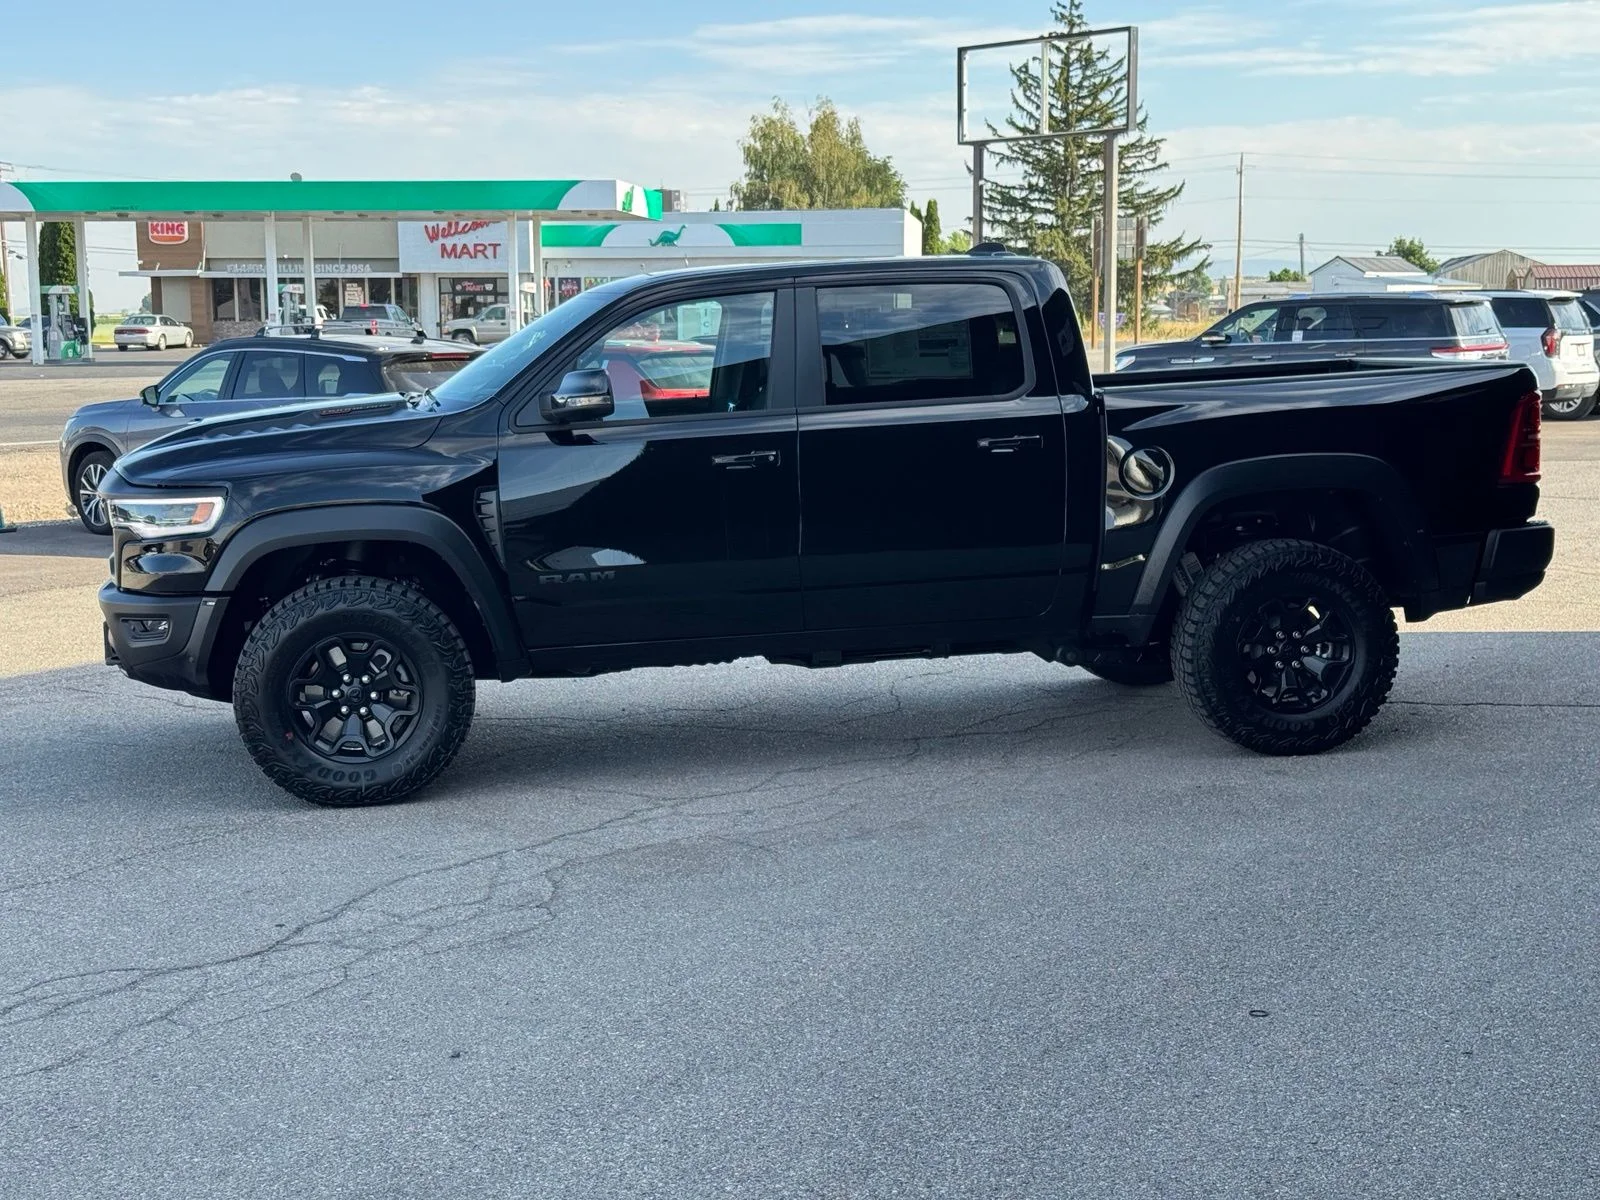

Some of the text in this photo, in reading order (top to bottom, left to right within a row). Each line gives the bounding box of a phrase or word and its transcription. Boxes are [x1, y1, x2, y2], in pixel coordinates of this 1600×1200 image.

[150, 222, 185, 235] KING
[441, 243, 501, 259] MART
[314, 263, 346, 273] SINCE
[538, 570, 617, 585] RAM
